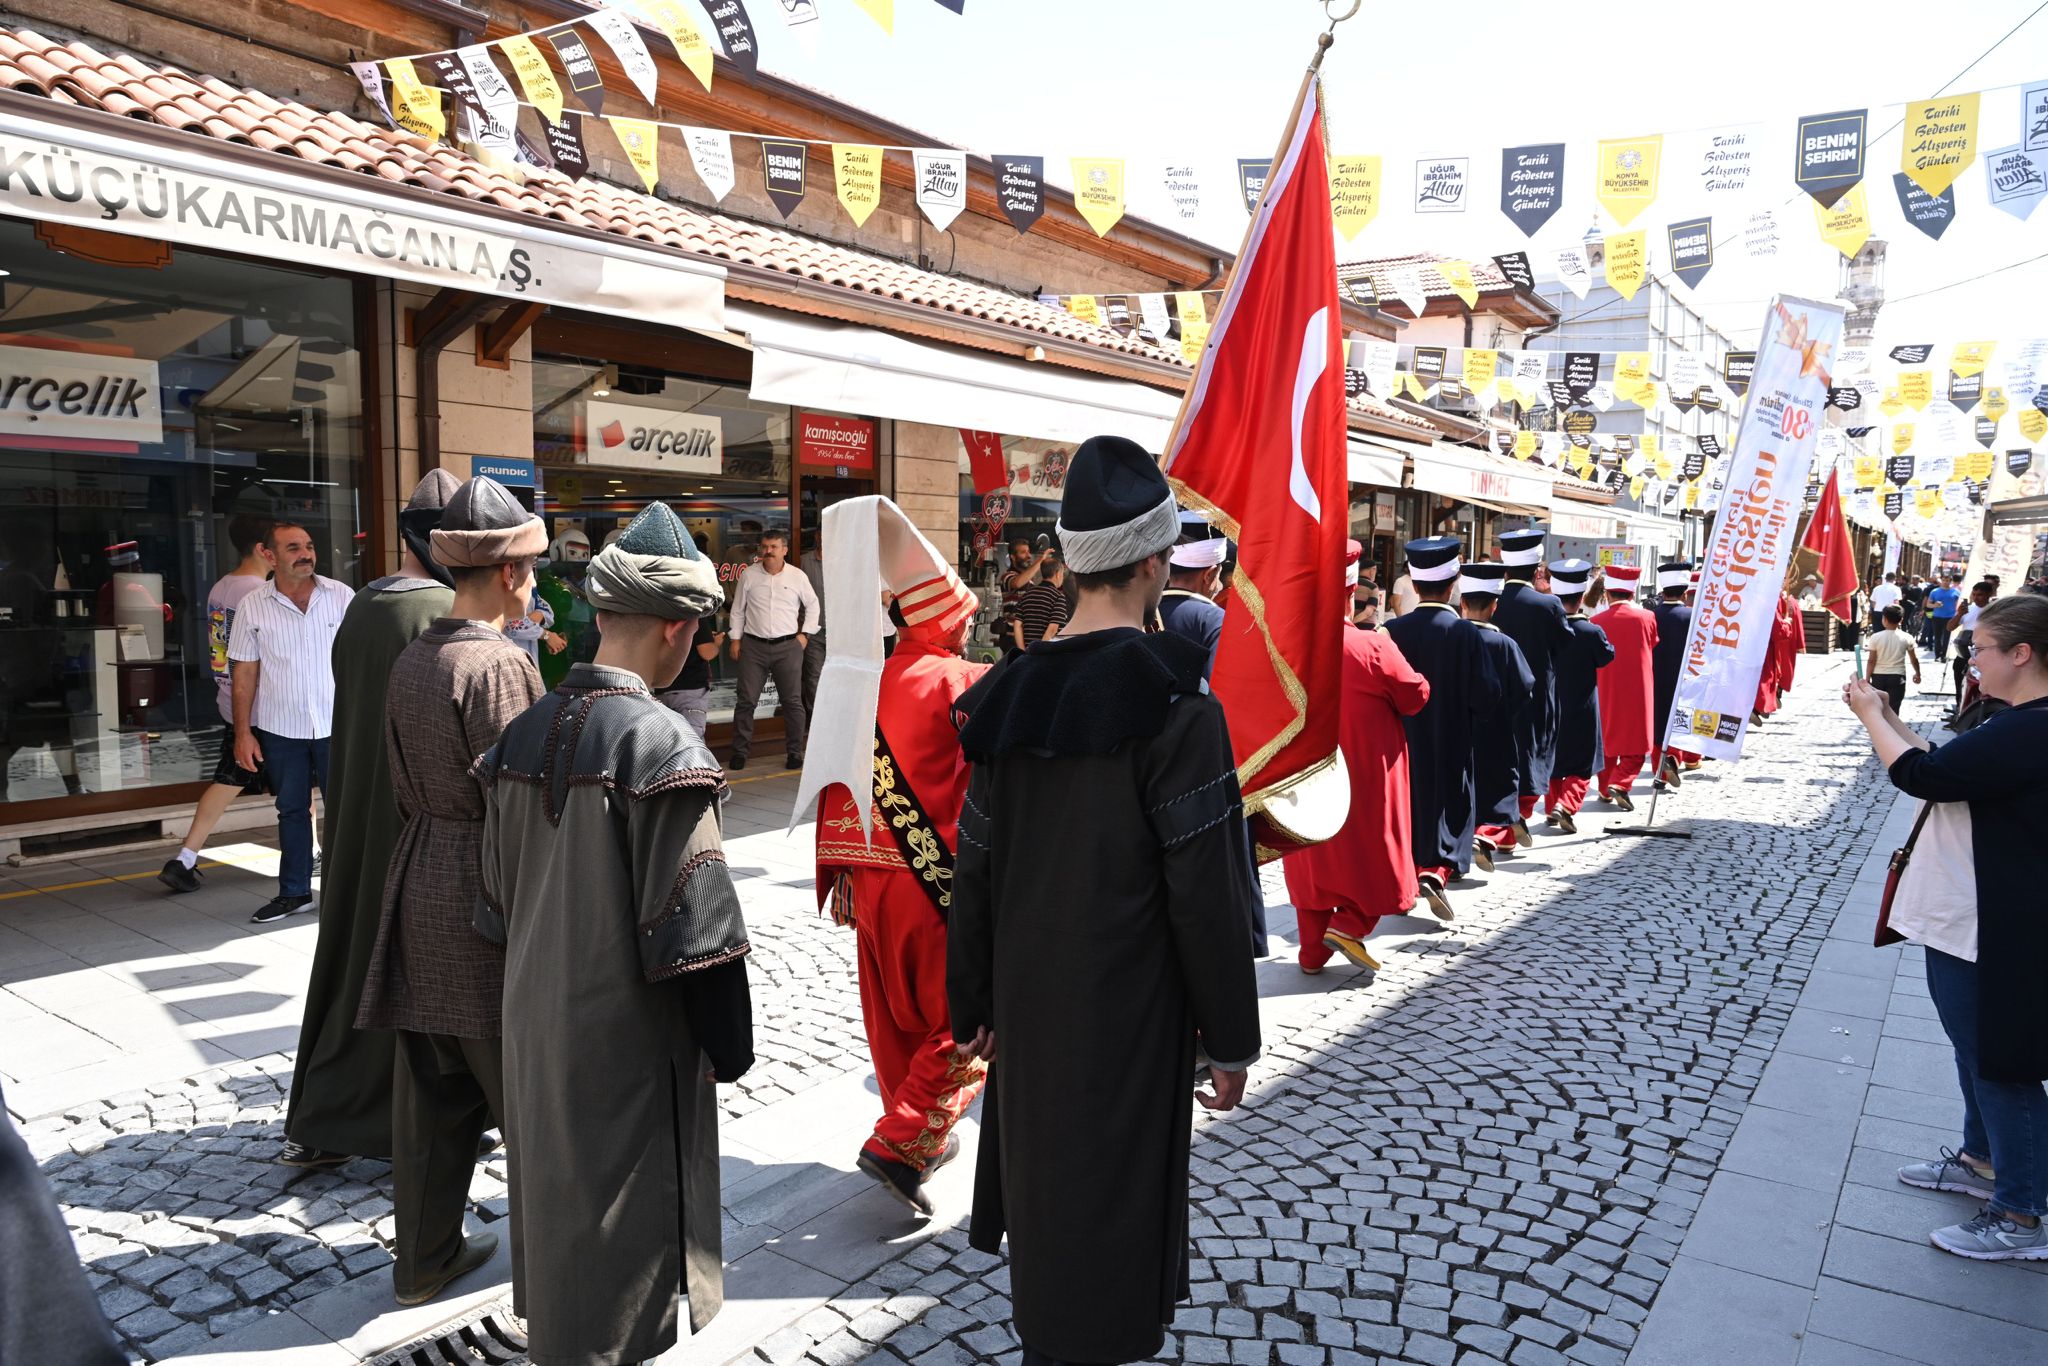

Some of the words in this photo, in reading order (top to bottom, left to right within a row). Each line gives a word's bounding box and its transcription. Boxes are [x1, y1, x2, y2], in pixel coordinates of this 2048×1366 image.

[1924, 104, 1960, 120] Tarihi
[1915, 123, 1967, 137] Bedesten
[1712, 134, 1746, 147] Tarihi
[1805, 133, 1858, 151] BENİM
[1911, 139, 1967, 153] Alışveriş
[768, 154, 802, 169] BENİM
[845, 152, 869, 164] Tarihi
[1517, 154, 1549, 167] Tarihi
[1704, 149, 1751, 162] Bedesten
[1804, 148, 1857, 166] ŞEHRİM
[1916, 153, 1960, 170] Günleri
[842, 166, 874, 178] Bedesten
[929, 161, 951, 170] UĞUR
[1005, 163, 1032, 174] Tarihi
[1166, 167, 1193, 177] Tarihi
[1337, 163, 1366, 174] Tarihi
[1429, 163, 1456, 174] UĞUR
[1700, 164, 1751, 178] Alışveriş
[768, 167, 802, 182] ŞEHRİM
[925, 168, 957, 178] İBRAHİM
[1423, 172, 1462, 182] İBRAHİM
[1511, 168, 1554, 182] Bedesten
[842, 178, 875, 192] Alışveriş
[923, 176, 959, 198] Altay
[1002, 174, 1036, 188] Bedesten
[1331, 177, 1371, 189] Bedesten
[1605, 178, 1649, 188] BÜYÜKŞEHİR
[1705, 179, 1744, 192] Günleri
[846, 191, 872, 203] Günleri
[1001, 187, 1038, 203] Alışveriş
[1418, 180, 1464, 203] Altay
[1508, 183, 1555, 198] Alışveriş
[1331, 192, 1372, 205] Alışveriş
[1512, 198, 1550, 213] Günleri
[1006, 200, 1035, 213] Günleri
[1333, 205, 1367, 218] Günleri
[0, 146, 457, 271] KÜÇÜKARMAĞAN
[469, 241, 543, 292] A.Ş.
[0, 374, 148, 424] rçelik
[805, 424, 868, 446] kamışcıoğlu
[630, 425, 716, 460] arçelik
[479, 466, 528, 477] GRUNDIG
[1470, 470, 1510, 497] TINMAZ
